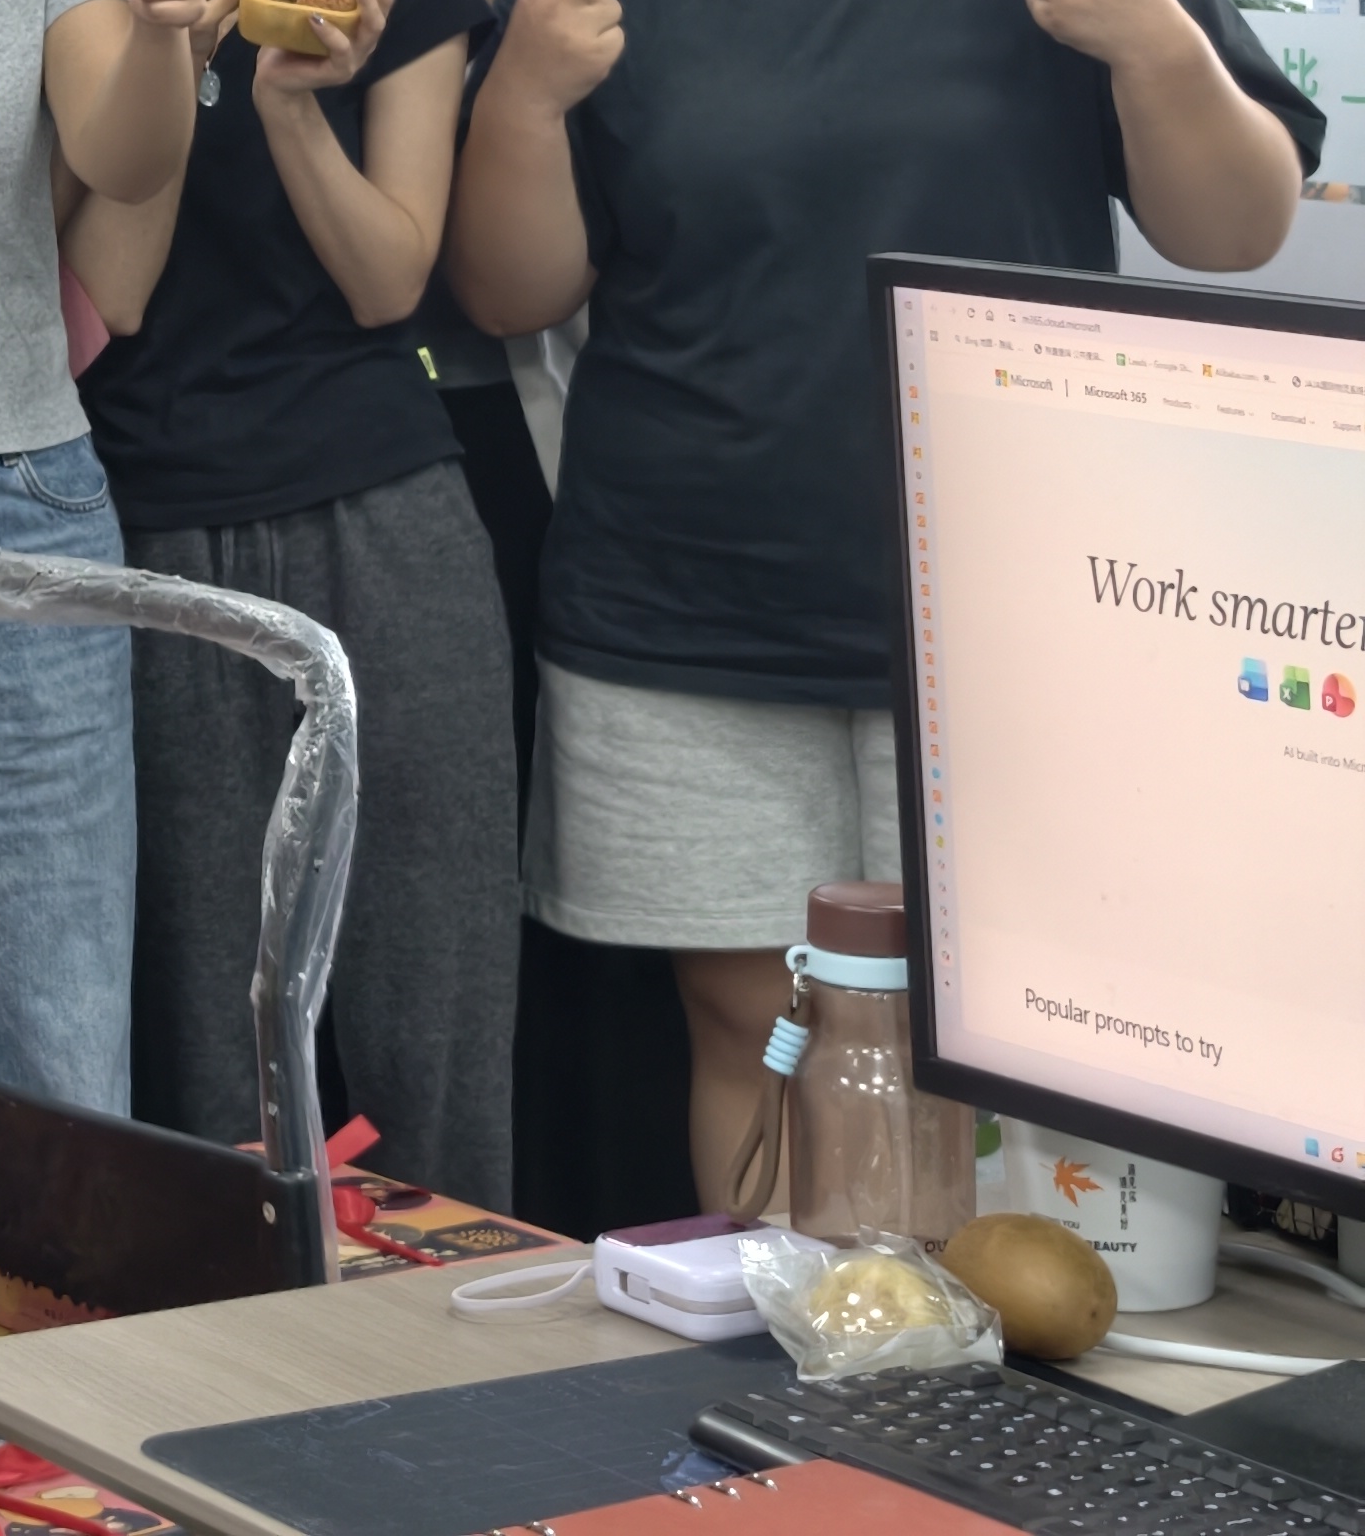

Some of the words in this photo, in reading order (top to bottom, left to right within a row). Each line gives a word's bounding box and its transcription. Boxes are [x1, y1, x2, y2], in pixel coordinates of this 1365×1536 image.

[1010, 373, 1054, 392] Microsoft
[1084, 384, 1128, 402] Microsoft
[1130, 390, 1148, 405] 365
[1087, 555, 1199, 622] Work
[1025, 986, 1091, 1027] Popular
[1094, 1010, 1171, 1048] prompts
[1175, 1029, 1194, 1054] to
[1198, 1036, 1224, 1067] try
